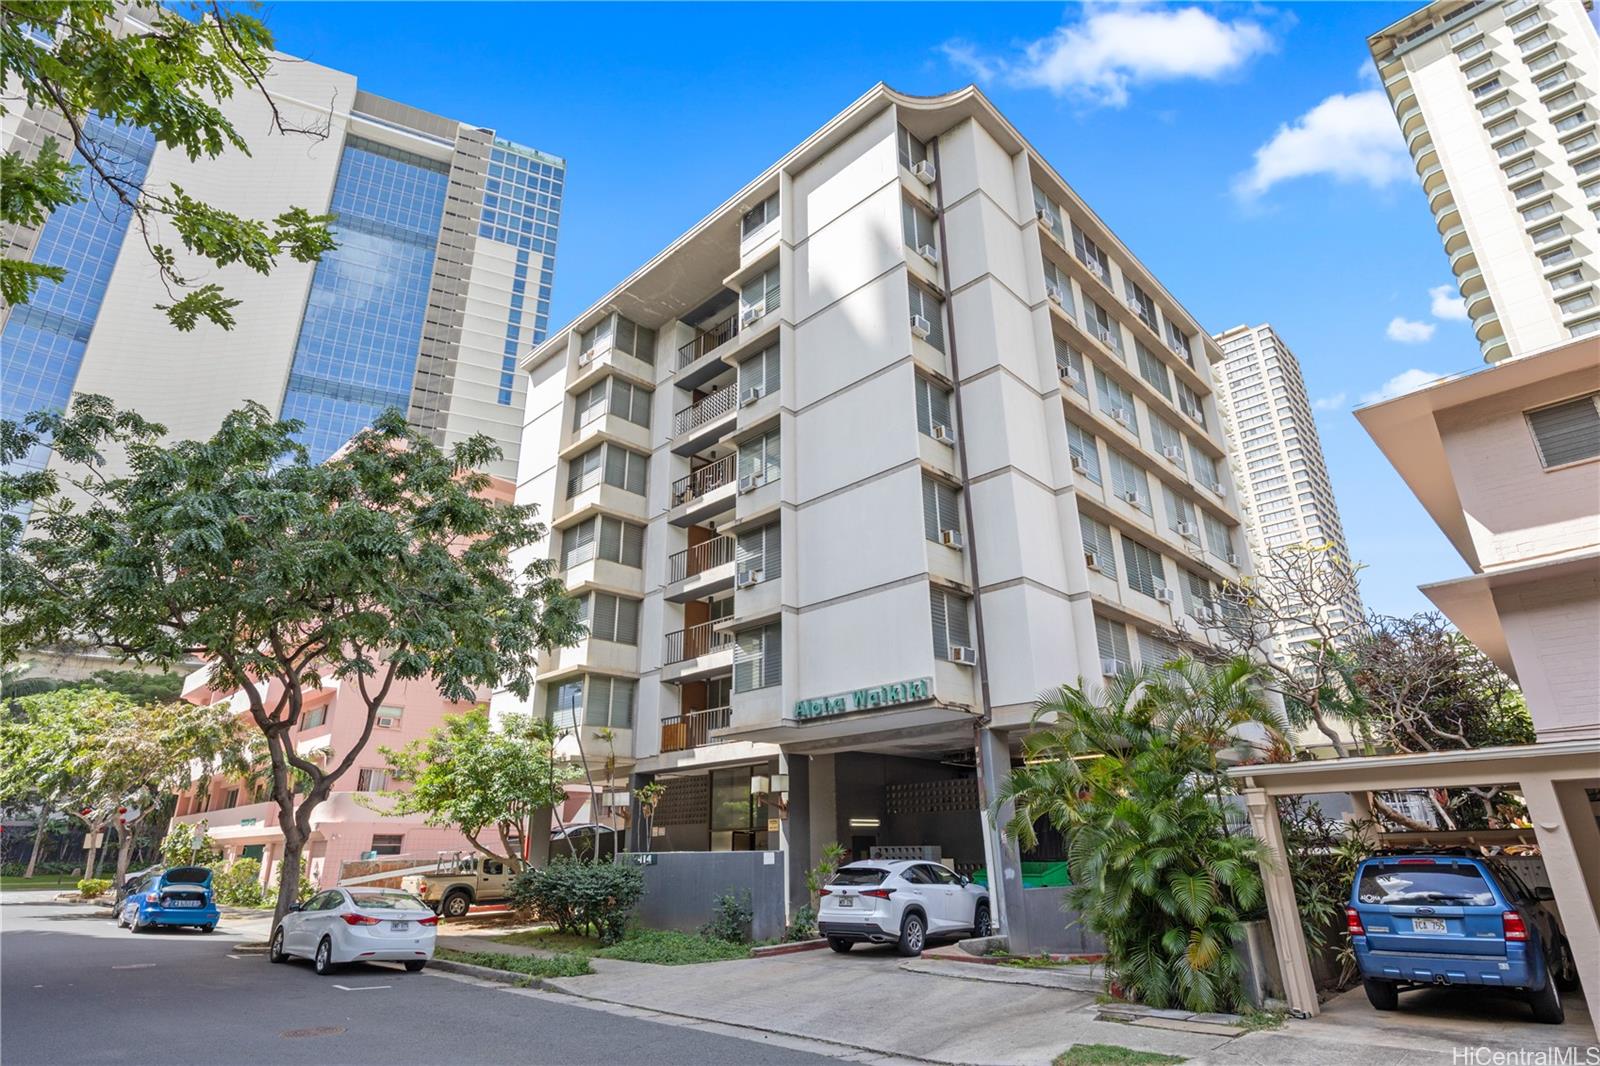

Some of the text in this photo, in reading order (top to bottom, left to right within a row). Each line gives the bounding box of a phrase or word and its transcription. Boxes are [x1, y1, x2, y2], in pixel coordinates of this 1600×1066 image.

[795, 679, 929, 718] Aloha Waikiki
[1360, 894, 1381, 903] ALOHA
